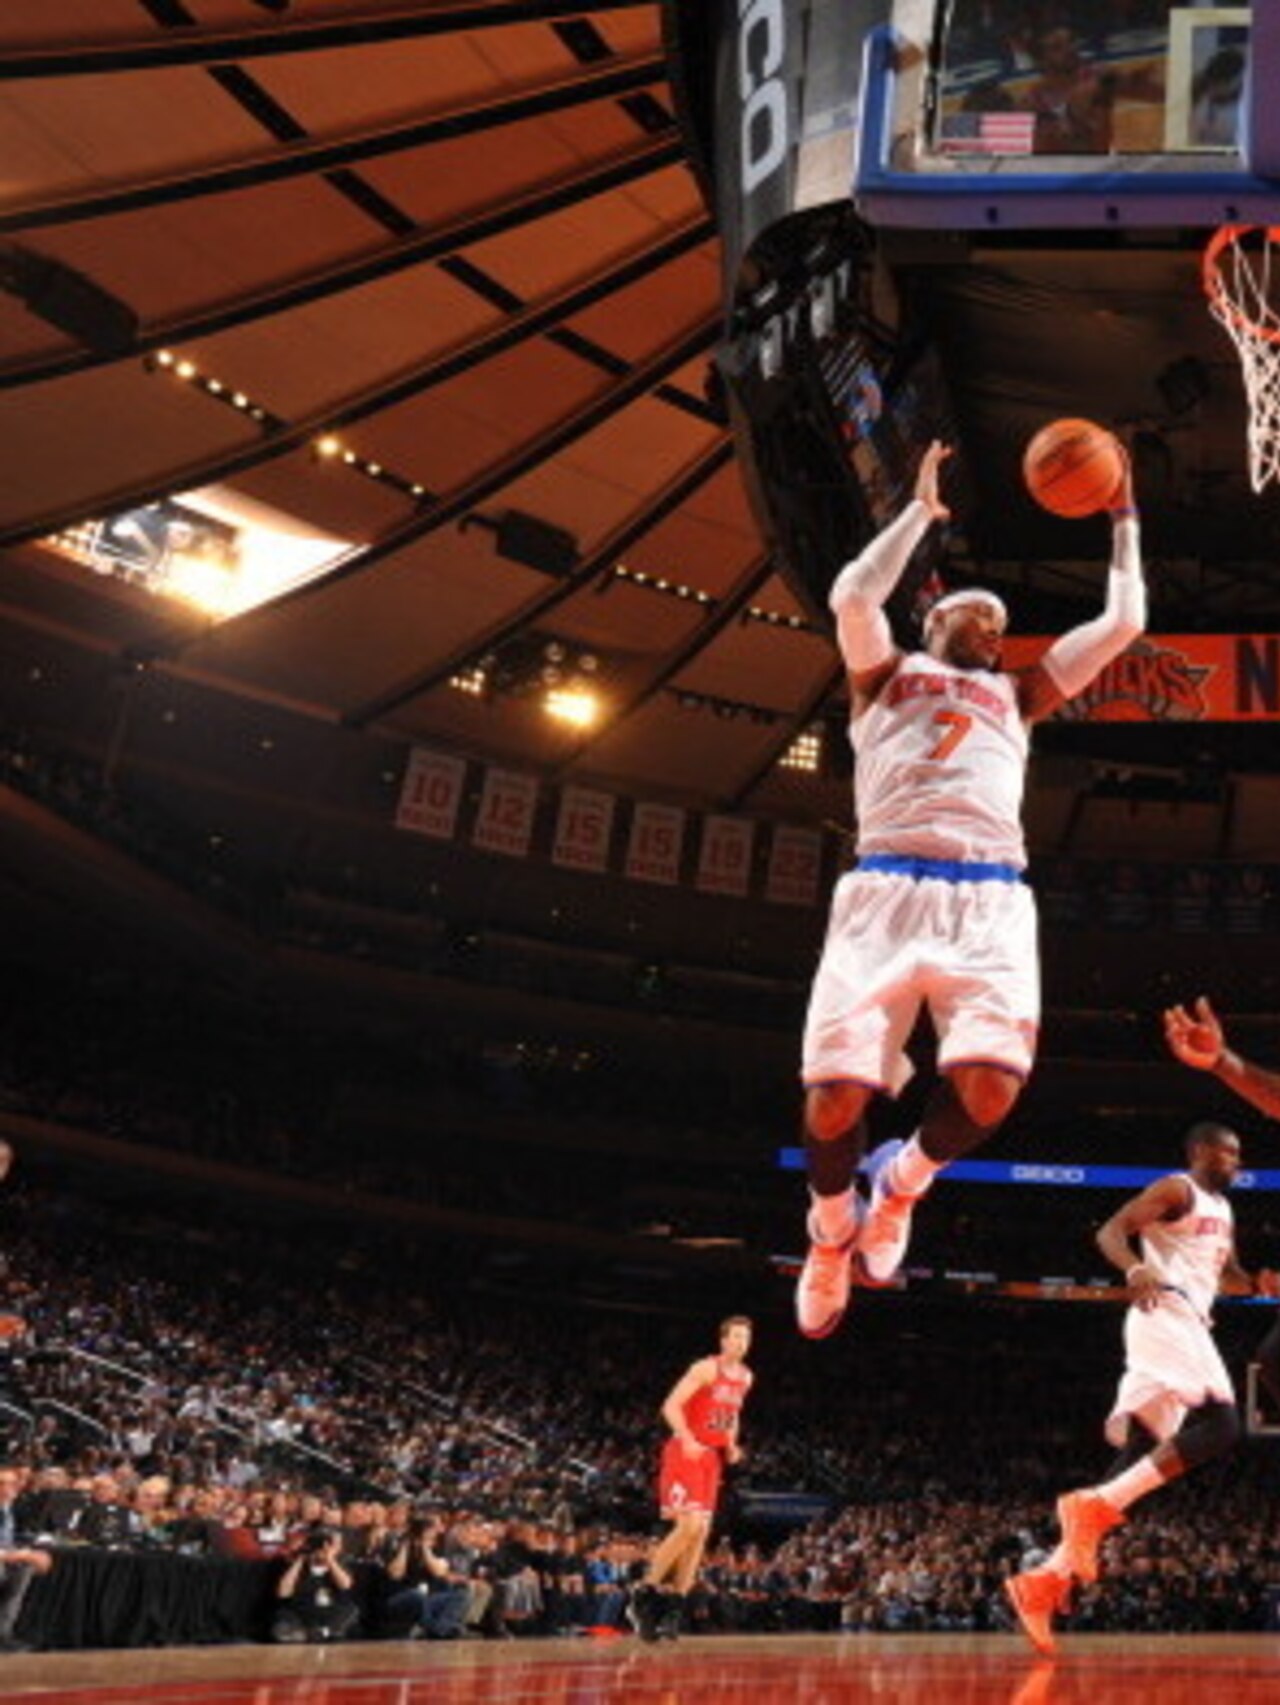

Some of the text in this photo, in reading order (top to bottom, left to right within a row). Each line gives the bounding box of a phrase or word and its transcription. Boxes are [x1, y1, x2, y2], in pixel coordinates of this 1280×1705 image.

[929, 709, 974, 760] 7
[412, 771, 450, 809] 10
[485, 793, 525, 829] 12
[565, 812, 602, 847] 15
[1011, 1164, 1085, 1184] GEICO
